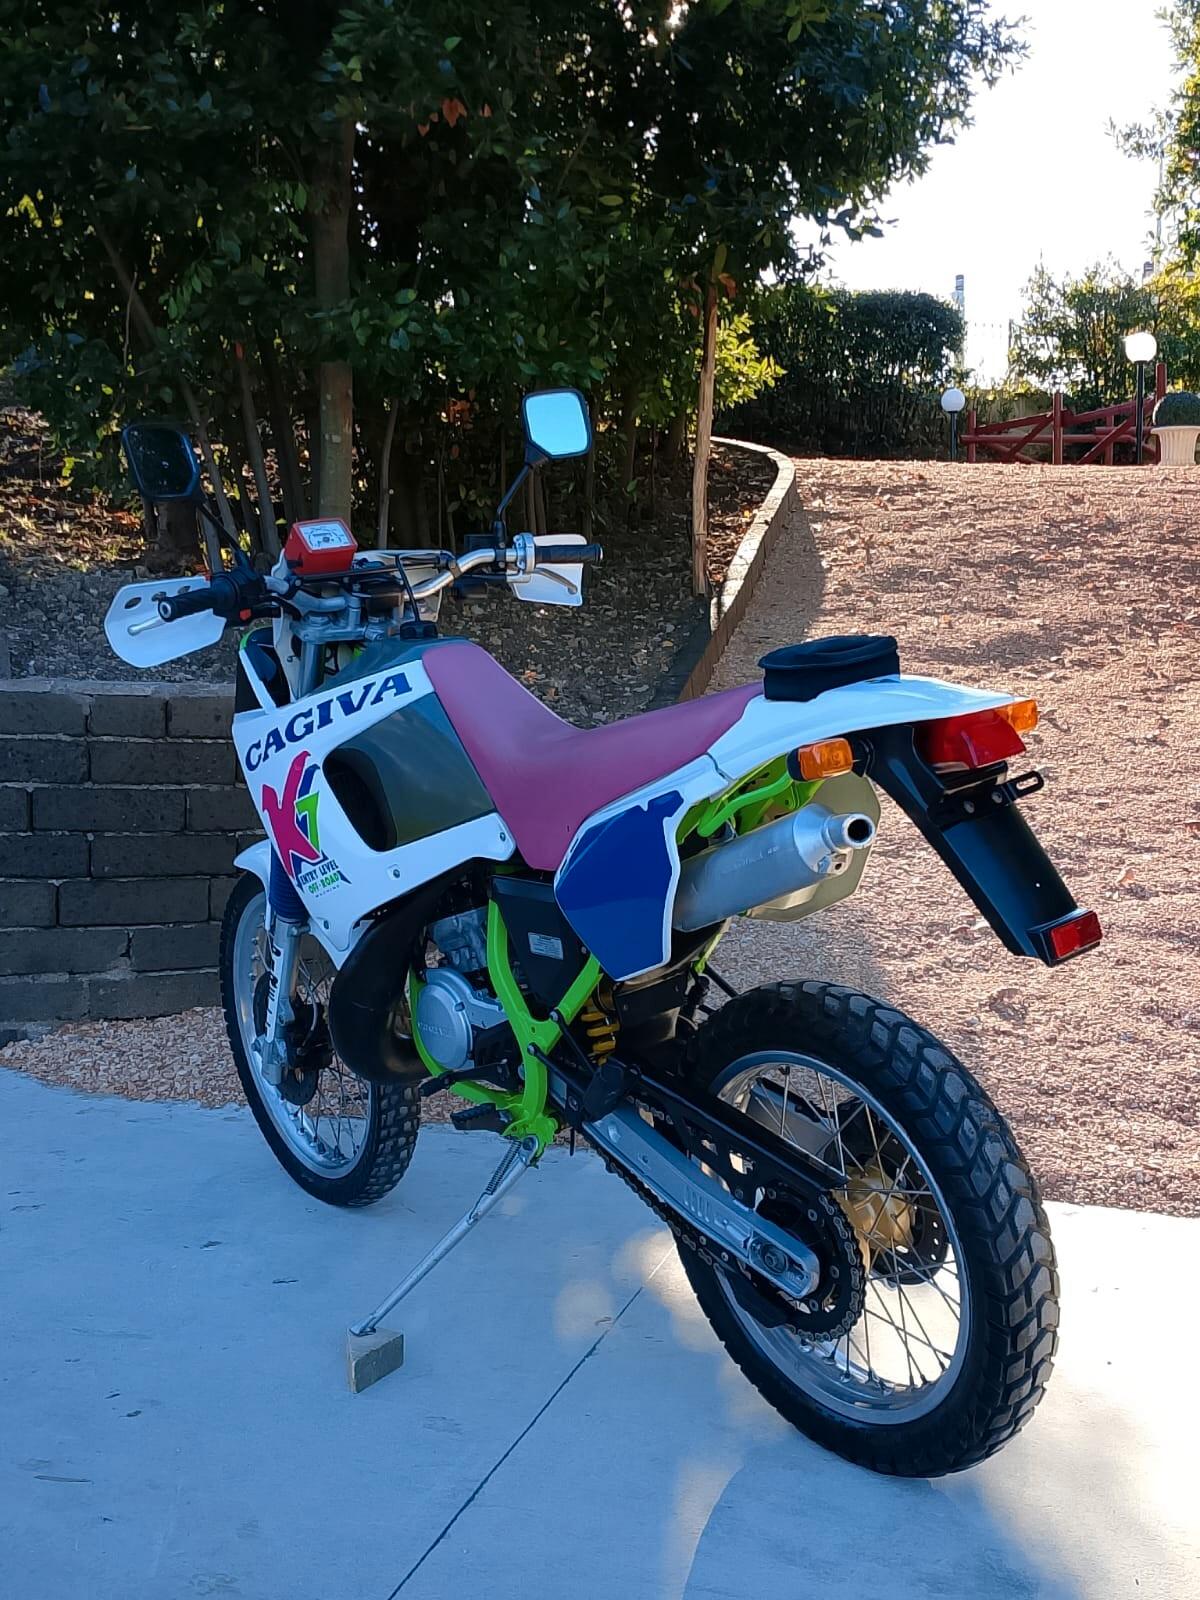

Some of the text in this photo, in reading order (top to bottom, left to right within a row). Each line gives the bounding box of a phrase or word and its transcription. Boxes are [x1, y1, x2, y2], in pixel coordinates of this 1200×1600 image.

[245, 672, 412, 772] CAGIVA
[299, 859, 339, 885] ENTRY LEVEL
